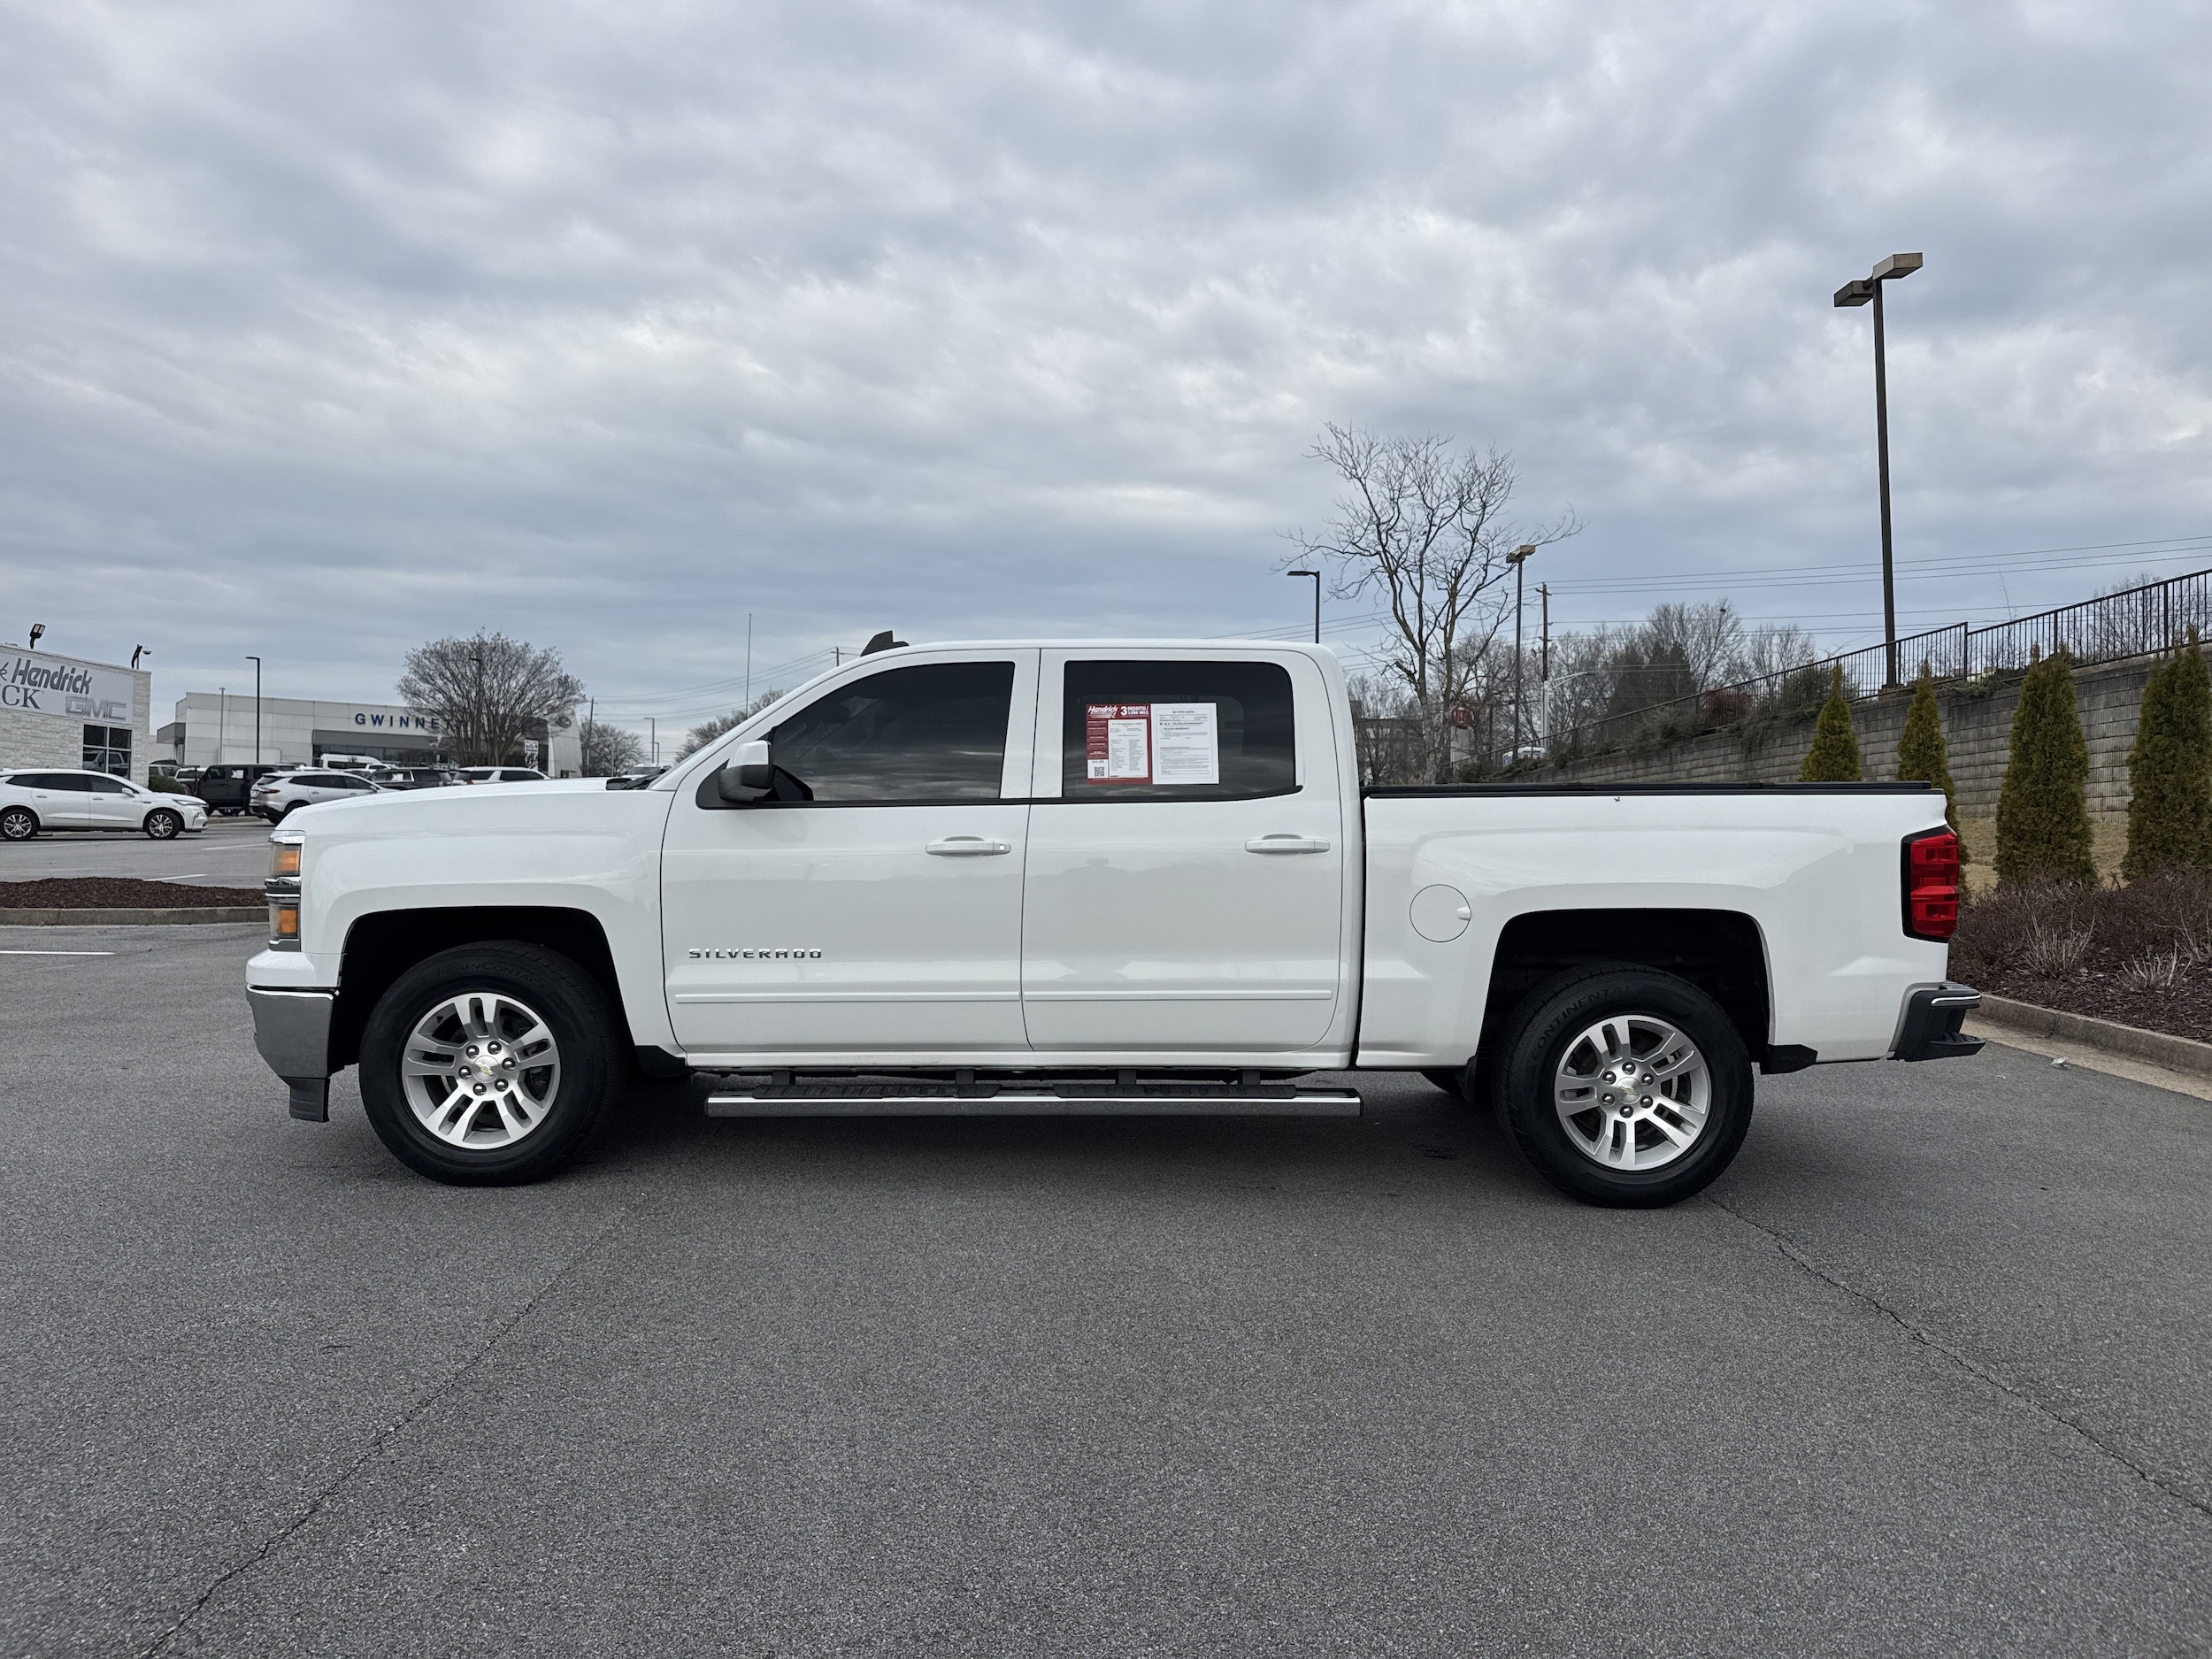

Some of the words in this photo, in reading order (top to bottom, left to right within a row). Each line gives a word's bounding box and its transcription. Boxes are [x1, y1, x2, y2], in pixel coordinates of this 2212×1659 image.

[11, 657, 93, 695] Hendrick
[65, 695, 127, 722] GMC
[1120, 706, 1127, 716] 3
[355, 713, 453, 729] GWINNET
[688, 949, 823, 958] SILVERADO
[1532, 984, 1634, 1061] CONTINENTAL
